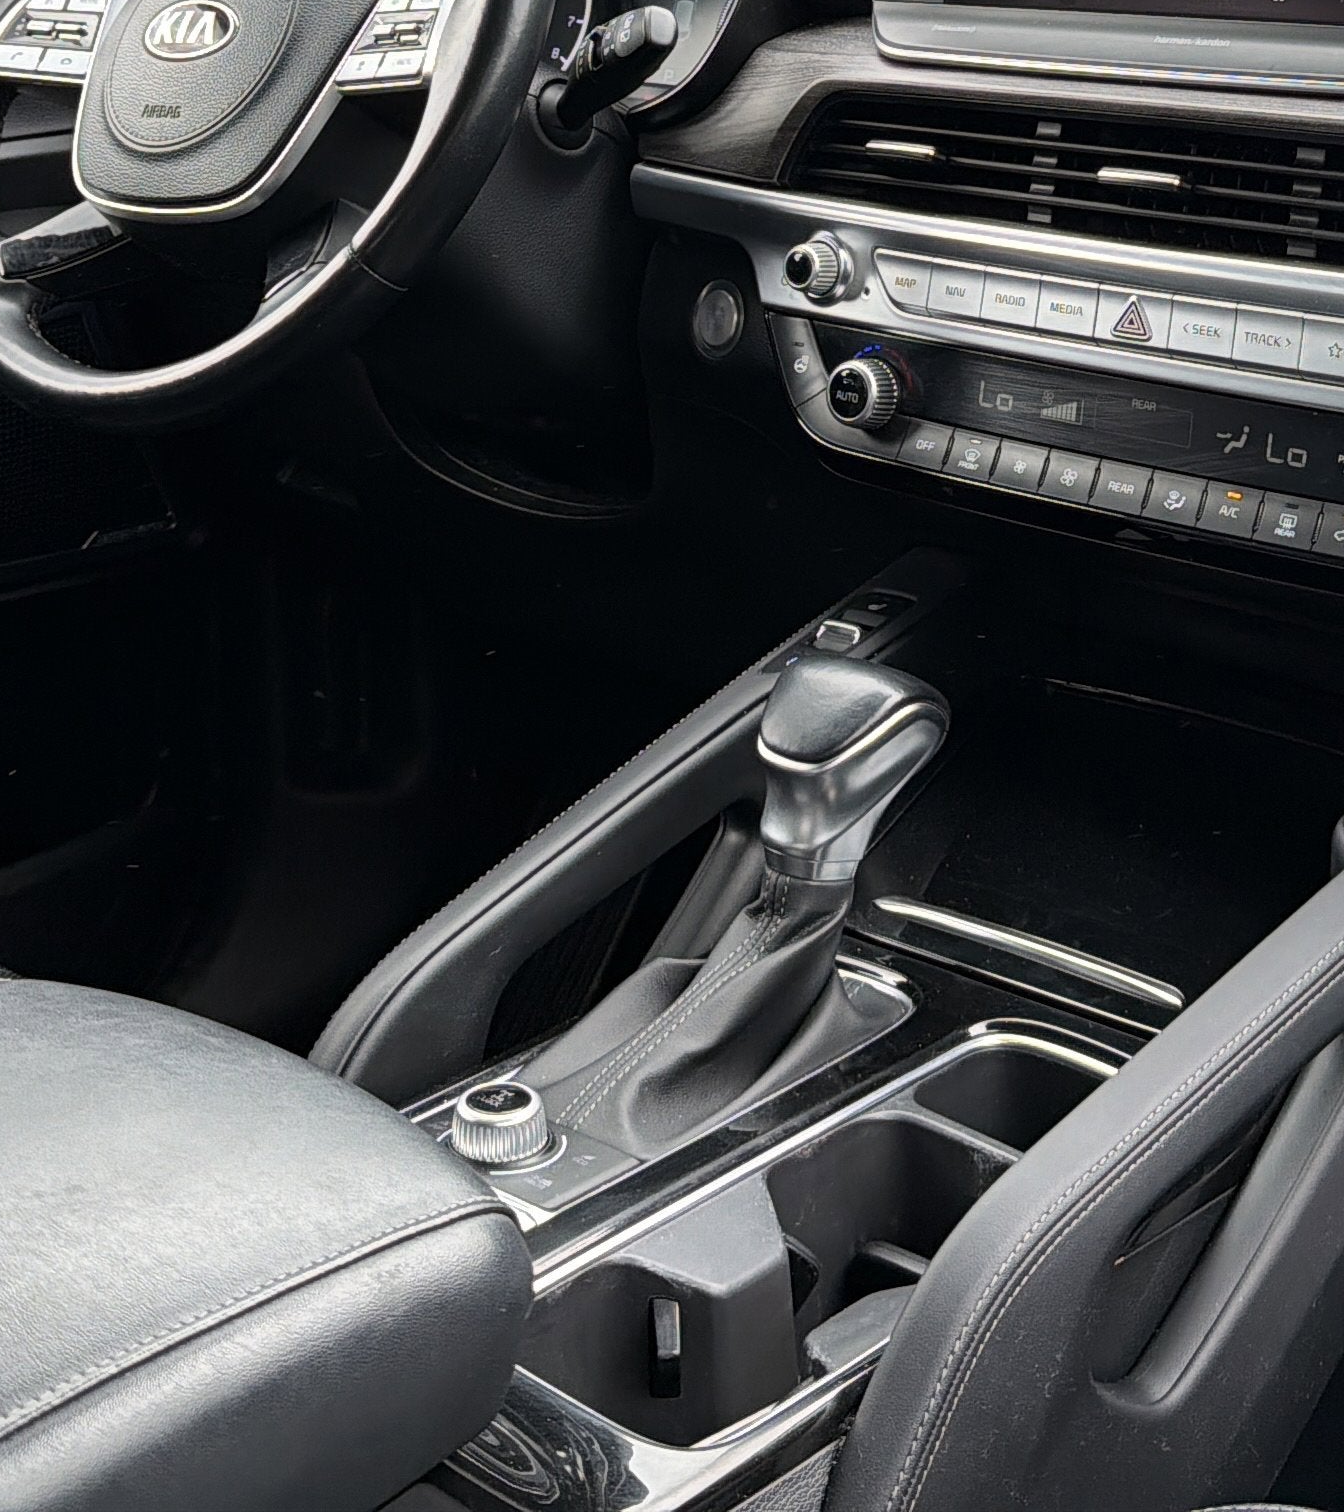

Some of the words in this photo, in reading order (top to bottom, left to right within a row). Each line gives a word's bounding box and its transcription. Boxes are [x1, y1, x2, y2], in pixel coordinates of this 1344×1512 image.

[153, 8, 217, 46] KIA
[568, 16, 576, 27] 7
[551, 47, 560, 60] 8
[141, 103, 182, 119] AIRBAG
[894, 276, 917, 289] MAP
[945, 285, 966, 298] NAV
[995, 293, 1026, 307] RADIO
[1049, 301, 1083, 316] MEDIA
[1192, 323, 1221, 338] SEEK
[1244, 331, 1282, 348] TRACK
[836, 389, 859, 404] AUTO
[977, 380, 1013, 411] Lo
[1131, 398, 1156, 412] REAR
[1266, 433, 1308, 468] Lo
[915, 439, 935, 451] OFF
[957, 461, 980, 471] FRONT
[1108, 480, 1135, 495] REAR
[1219, 504, 1241, 519] A/C
[1274, 528, 1296, 538] REAR
